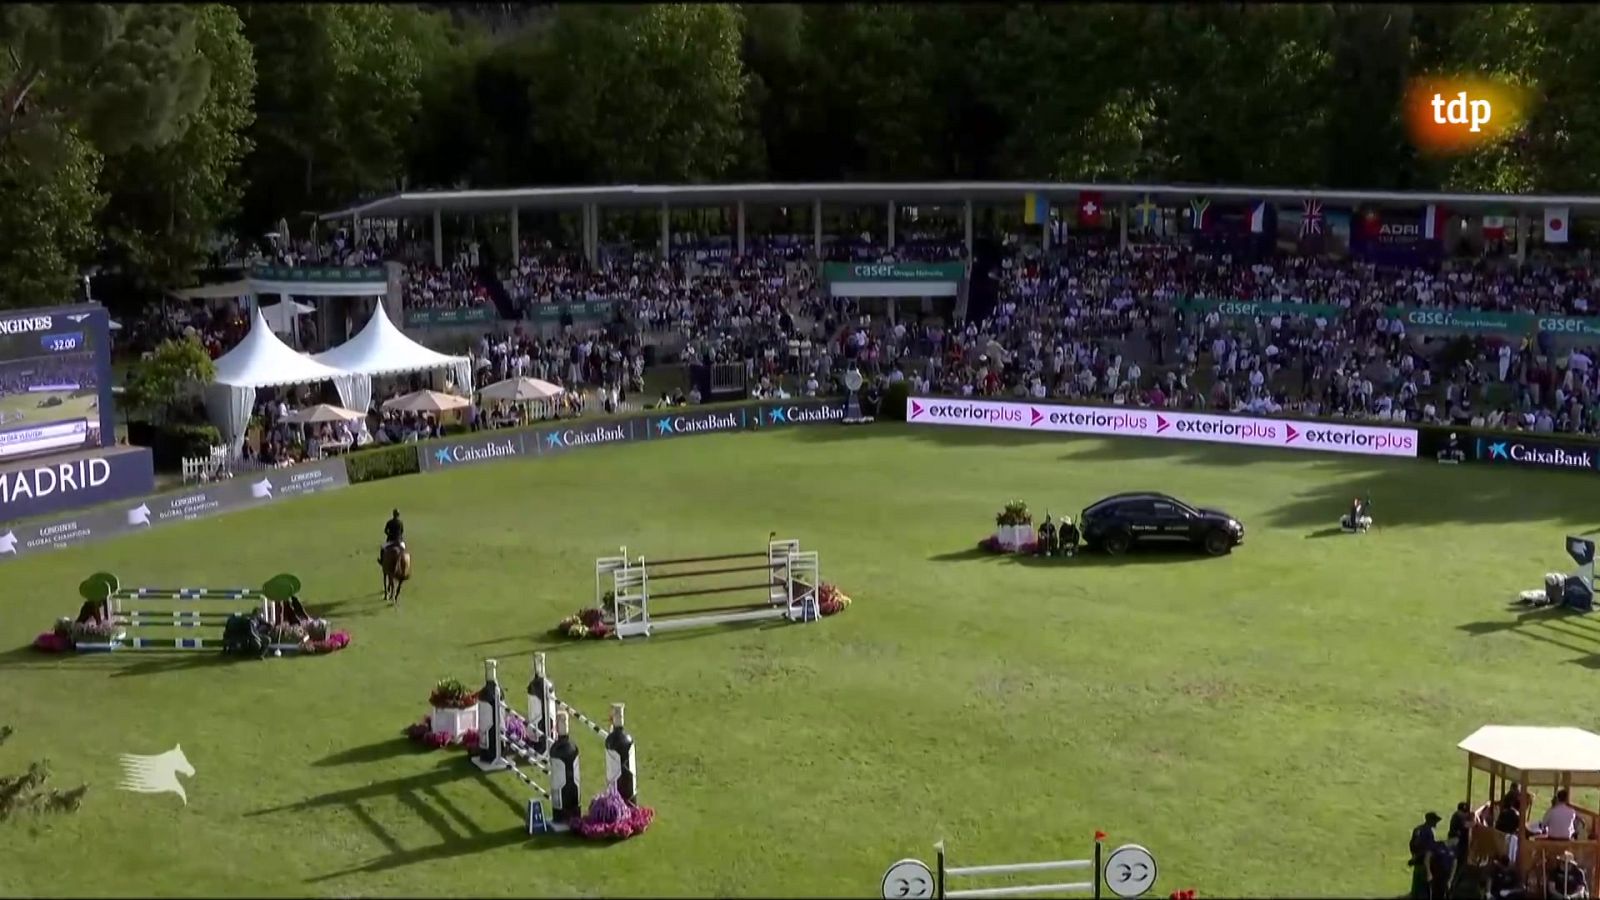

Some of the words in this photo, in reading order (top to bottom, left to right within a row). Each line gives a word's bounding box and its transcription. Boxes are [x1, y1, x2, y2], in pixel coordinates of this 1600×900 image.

[854, 264, 895, 277] caser
[1218, 301, 1259, 315] caser
[1408, 310, 1452, 326] caser
[1538, 317, 1585, 332] caser
[787, 404, 847, 422] CaixaBan
[674, 413, 737, 434] CaixaBank
[929, 403, 1022, 423] exteriorplus
[1049, 410, 1148, 431] exteriorplus
[1176, 418, 1276, 439] exteriorplus
[1306, 428, 1412, 450] exteriorplus
[563, 424, 625, 447] CaixaBank
[453, 439, 516, 462] CaixaBank
[1510, 444, 1592, 467] CaixaBank
